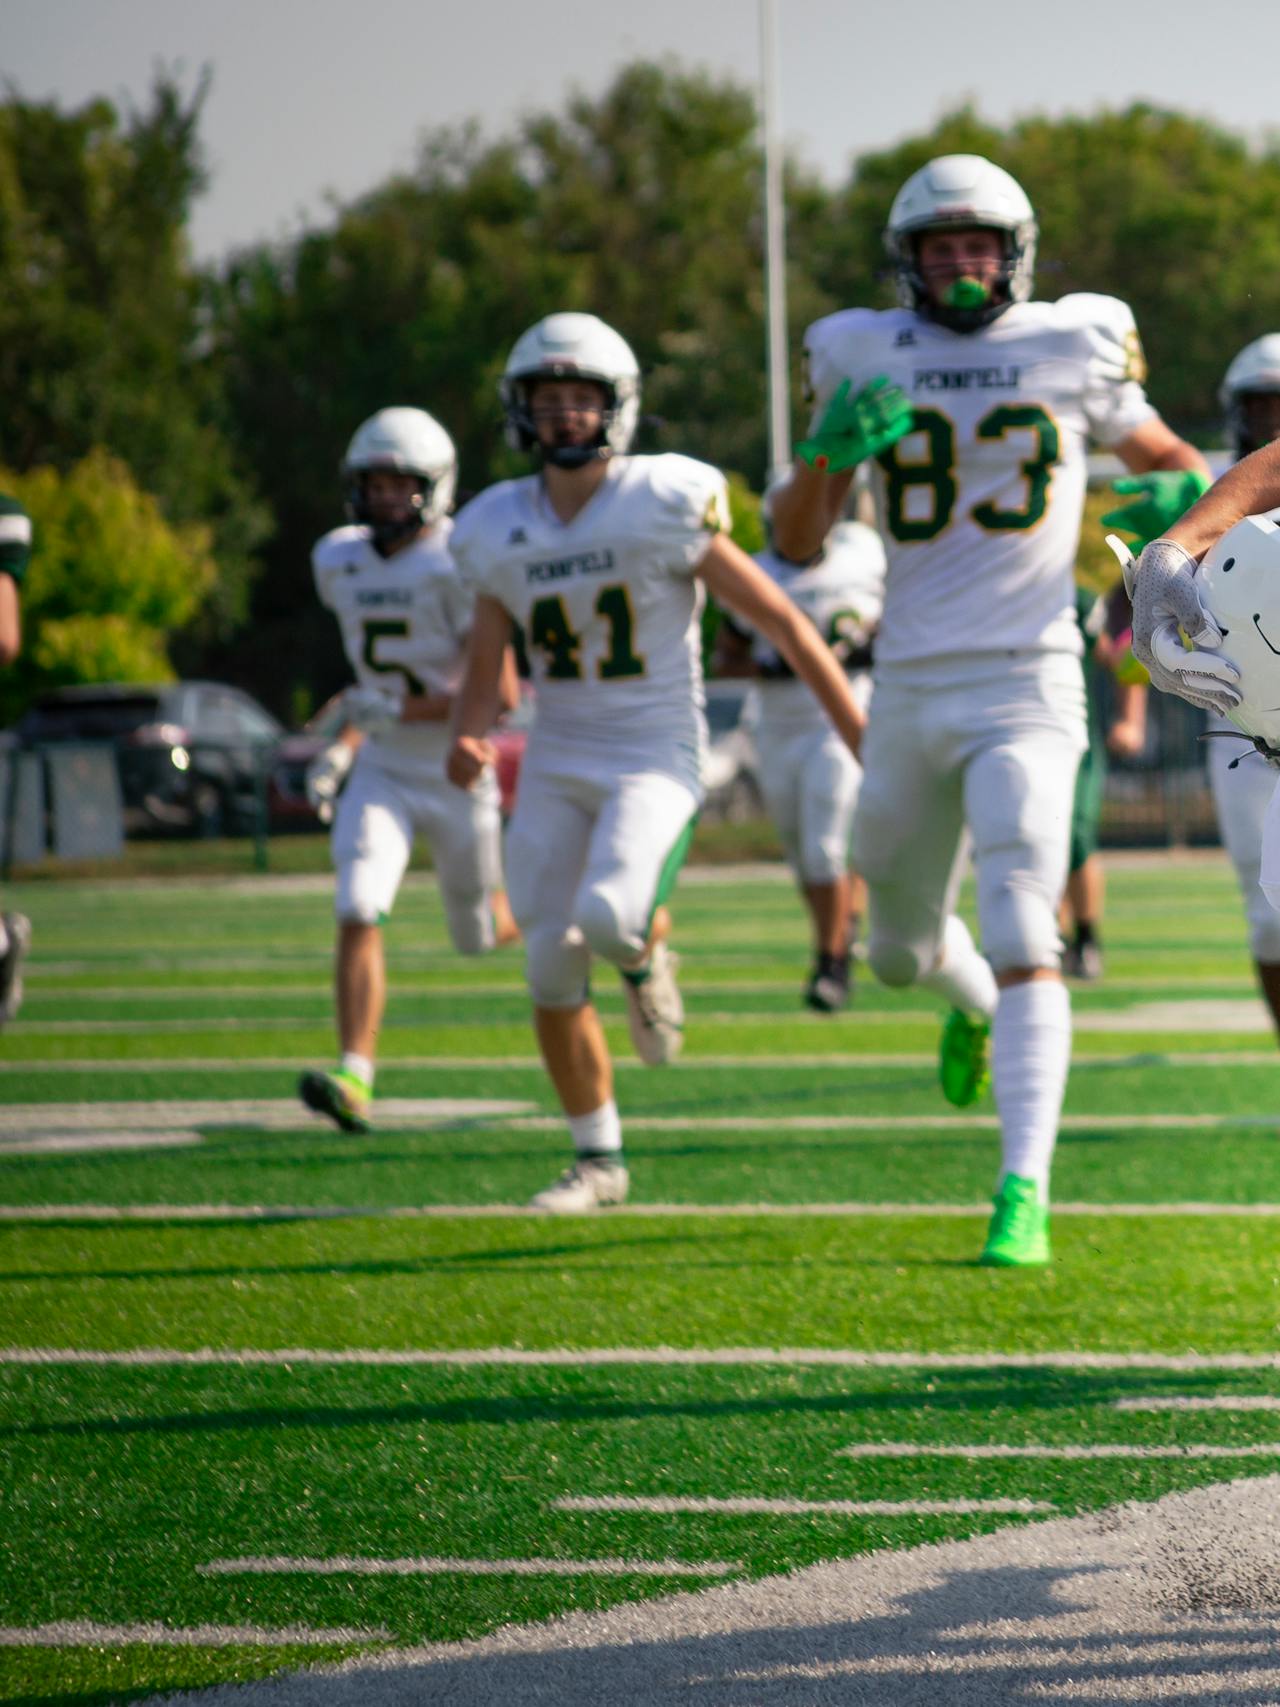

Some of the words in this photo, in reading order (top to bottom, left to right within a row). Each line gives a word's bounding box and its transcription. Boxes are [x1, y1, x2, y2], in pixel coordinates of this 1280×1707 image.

[913, 365, 1021, 393] PENNFIELD
[879, 402, 1062, 543] 83
[525, 547, 615, 585] PENNFIELD
[363, 617, 427, 698] 5
[530, 581, 647, 681] 41
